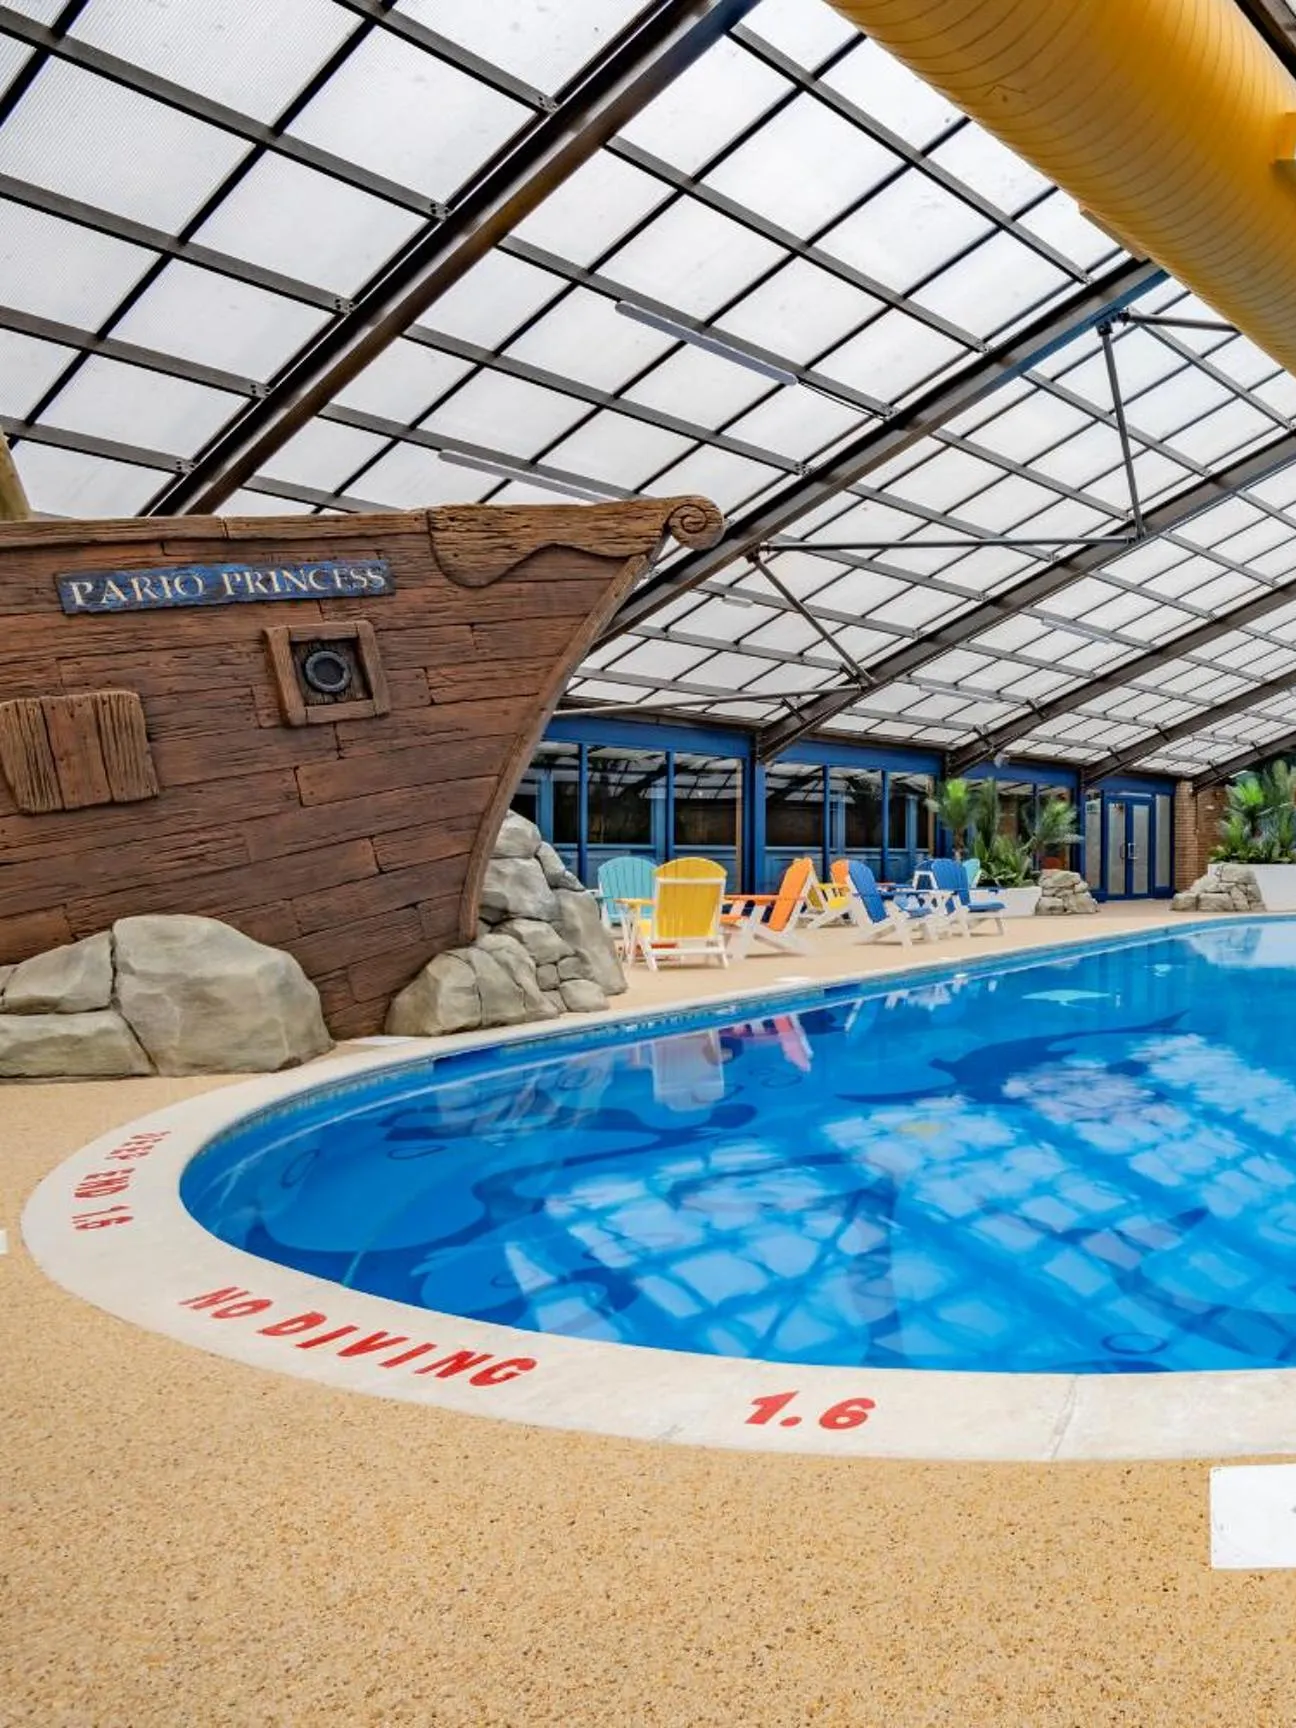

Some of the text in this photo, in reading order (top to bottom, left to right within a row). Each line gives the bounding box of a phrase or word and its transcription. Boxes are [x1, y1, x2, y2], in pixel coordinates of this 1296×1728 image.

[68, 566, 387, 606] PARIO PRINCESS
[74, 1167, 136, 1198] END
[178, 1286, 538, 1387] NO DIVING
[744, 1390, 877, 1430] 1.6
